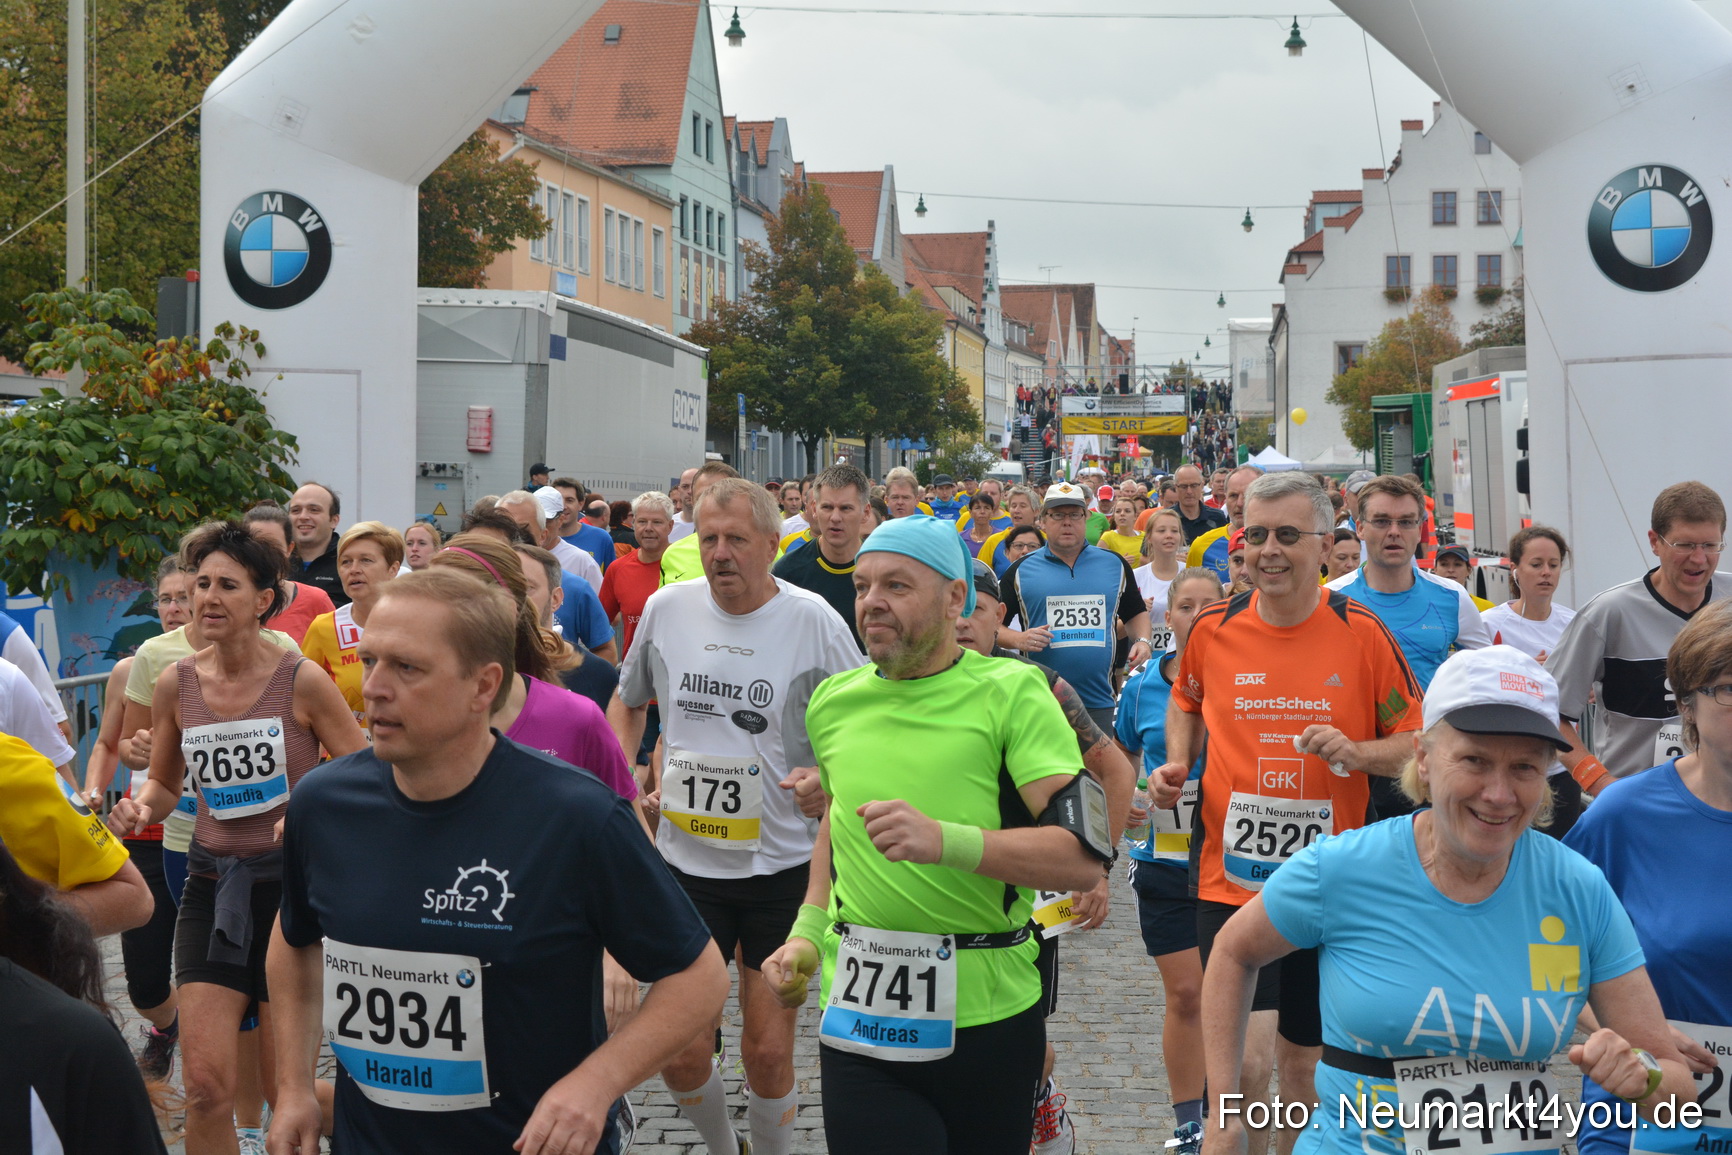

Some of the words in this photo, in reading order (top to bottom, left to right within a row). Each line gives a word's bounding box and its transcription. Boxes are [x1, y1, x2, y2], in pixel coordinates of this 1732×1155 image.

[1597, 167, 1704, 211] BMW
[231, 193, 323, 233] BMW
[673, 389, 701, 432] BOCK
[1103, 420, 1146, 431] START
[1053, 607, 1101, 628] 2533
[1060, 631, 1095, 640] Bernhard
[679, 672, 744, 701] Allianz
[1235, 673, 1266, 685] DAK
[1502, 681, 1527, 692] MOVE
[1234, 697, 1332, 712] SportScheck
[1246, 713, 1282, 721] Nürnberger
[1284, 713, 1313, 721] Stadtlauf
[184, 734, 213, 746] PARTL
[215, 729, 264, 742] Neumarkt
[1659, 732, 1682, 741] PAR
[192, 742, 276, 783] 2633
[668, 758, 695, 771] PARTL
[697, 763, 744, 775] Neumarkt
[1263, 771, 1297, 789] GfK
[213, 788, 264, 807] Claudia
[682, 775, 742, 814] 173
[1230, 801, 1263, 815] PARTL
[1265, 806, 1316, 819] Neumarkt
[690, 819, 728, 839] Georg
[422, 888, 478, 914] Spitz
[464, 921, 513, 931] Steuerberatung
[841, 935, 867, 952] PARTL
[869, 941, 931, 959] Neumarkt
[326, 954, 368, 977] PARTL
[372, 964, 449, 985] Neumarkt
[842, 956, 937, 1013] 2741
[336, 982, 467, 1052] 2934
[1403, 986, 1577, 1059] ANY
[850, 1018, 919, 1044] Andreas
[365, 1058, 433, 1088] Harald
[1400, 1062, 1462, 1082] PARTL
[1693, 1065, 1732, 1118] 2
[1421, 1079, 1552, 1151] 2142
